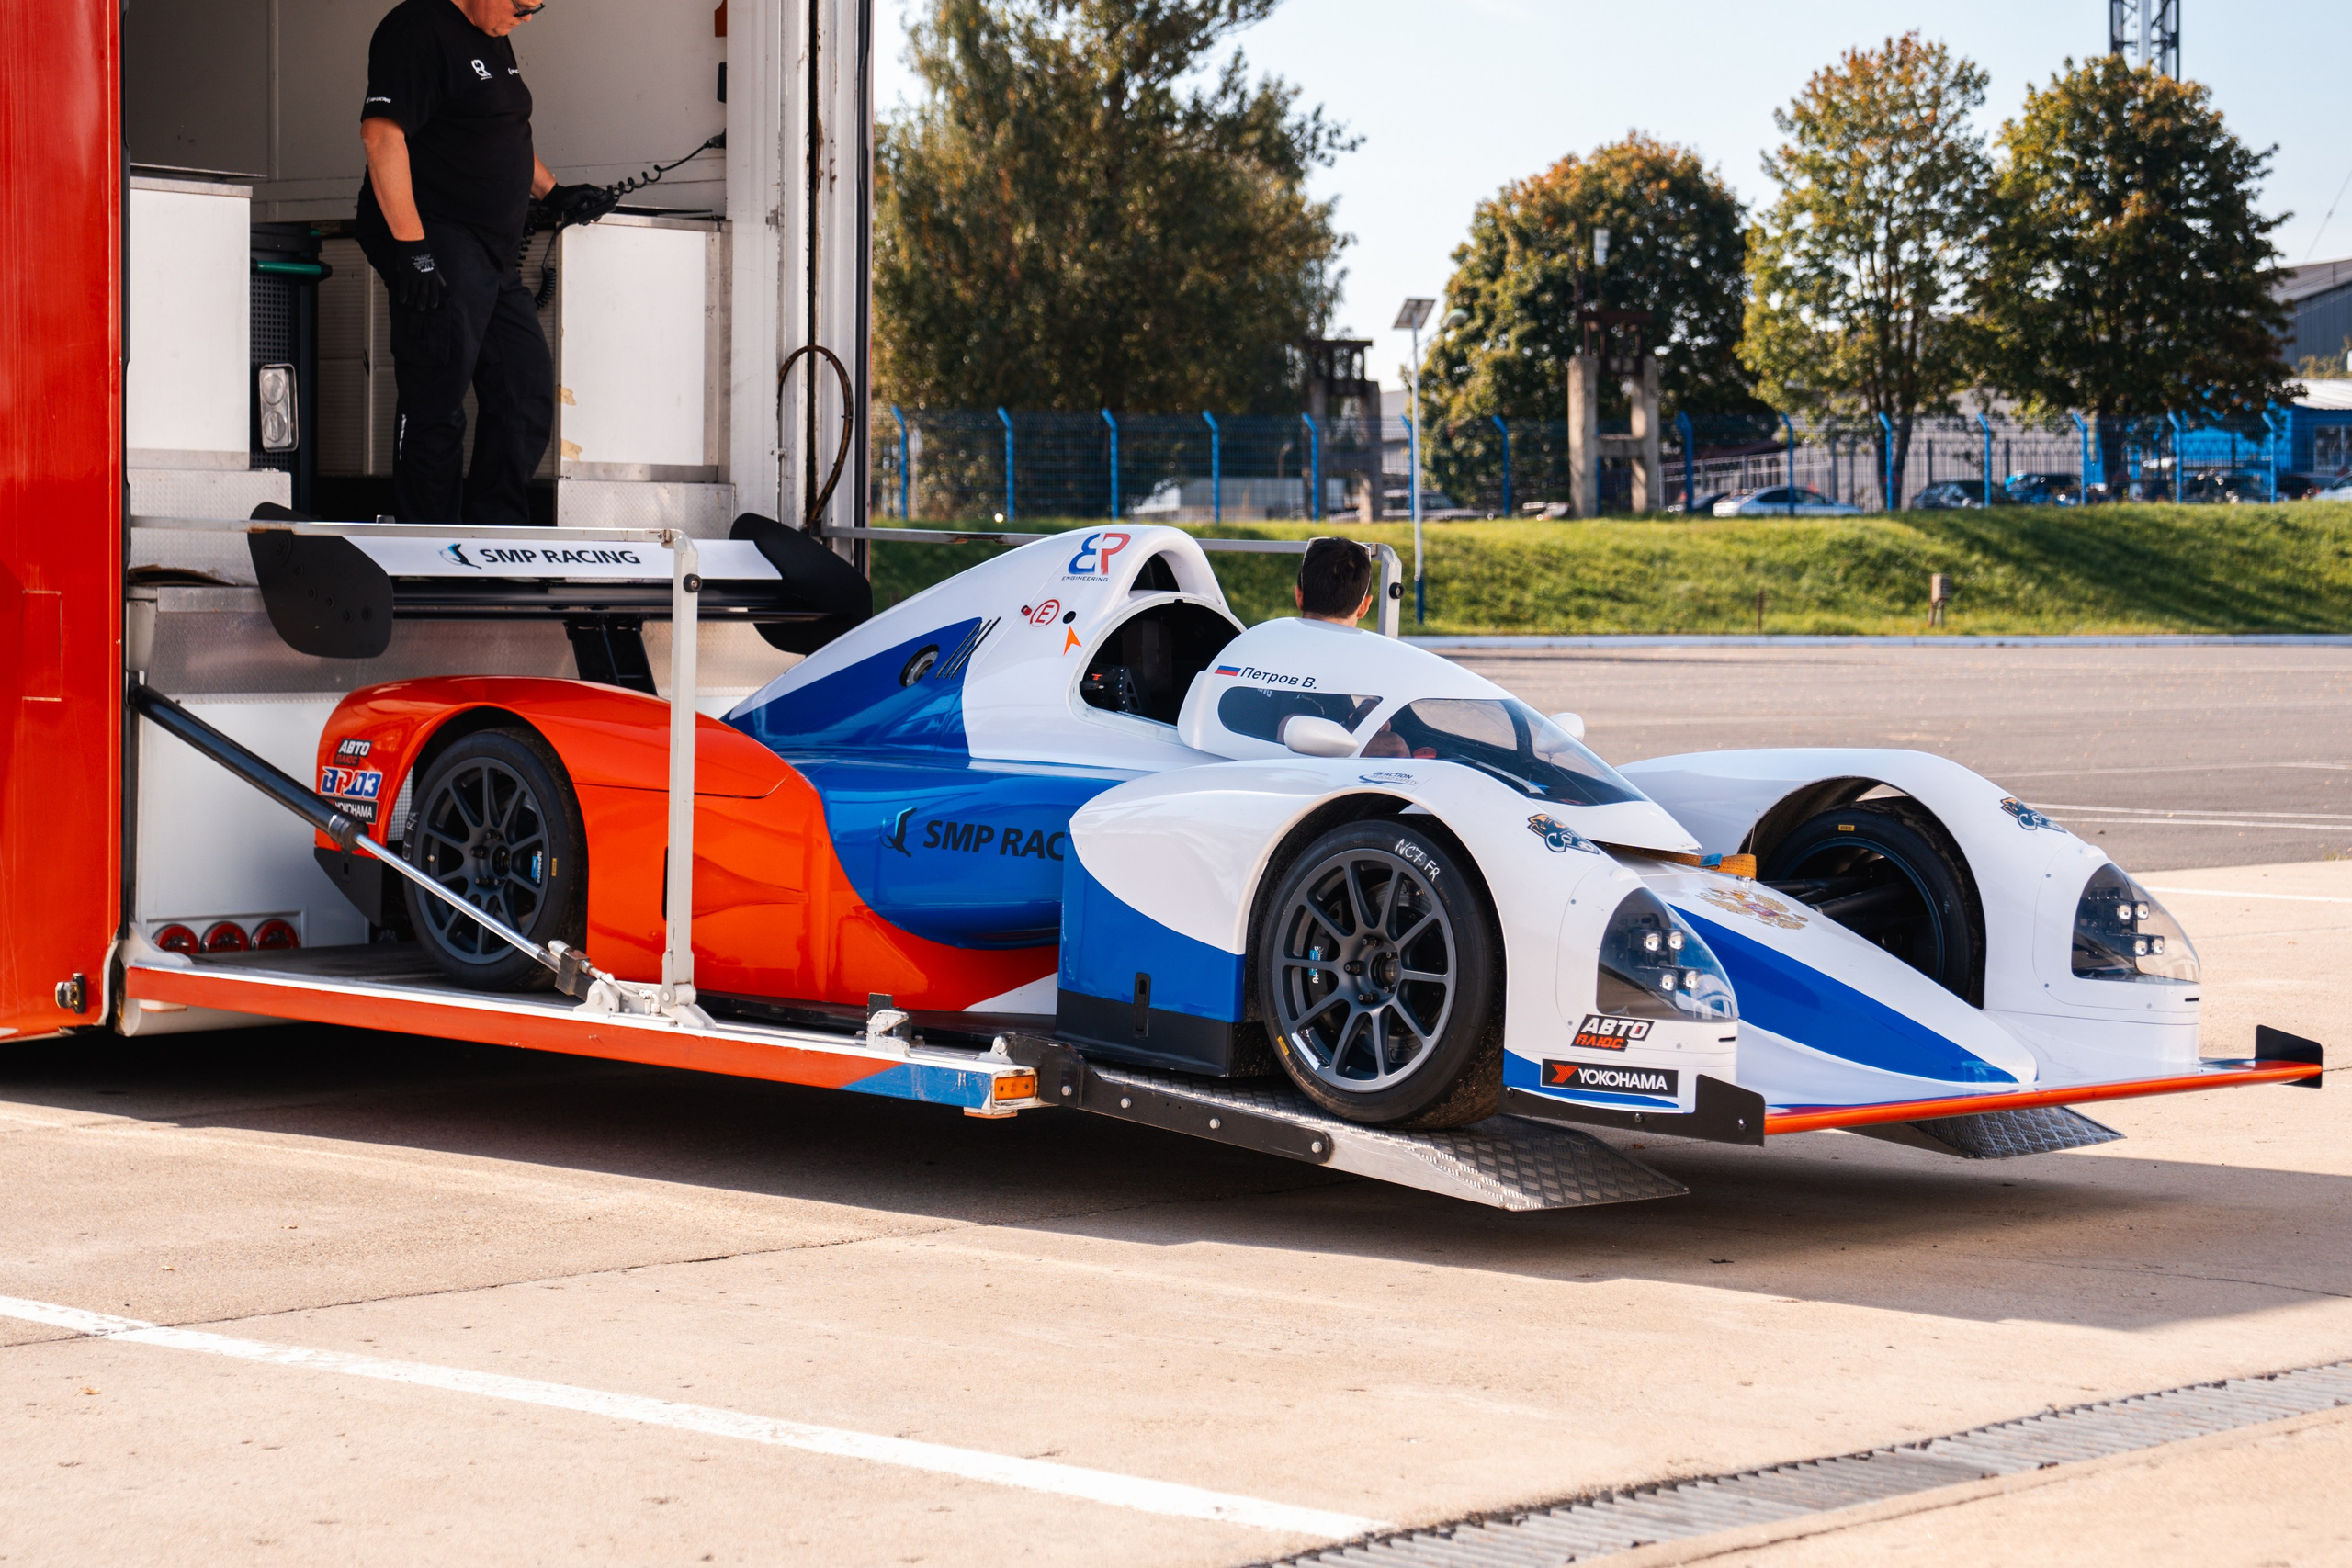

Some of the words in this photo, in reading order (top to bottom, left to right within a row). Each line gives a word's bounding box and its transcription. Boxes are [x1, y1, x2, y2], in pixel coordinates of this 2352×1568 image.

[479, 548, 537, 563] SMP
[540, 549, 641, 564] RACING
[1035, 604, 1055, 624] E
[1240, 667, 1299, 684] Петров
[1301, 676, 1317, 690] В.
[338, 739, 371, 757] АВТО
[335, 754, 358, 765] ПЛЮС
[923, 820, 995, 852] SMP
[1000, 827, 1065, 861] RAC
[1424, 860, 1441, 882] FR
[1580, 1017, 1650, 1039] АВТО
[1575, 1034, 1624, 1050] ПЛЮС
[1577, 1067, 1668, 1091] YOKOHAMA
